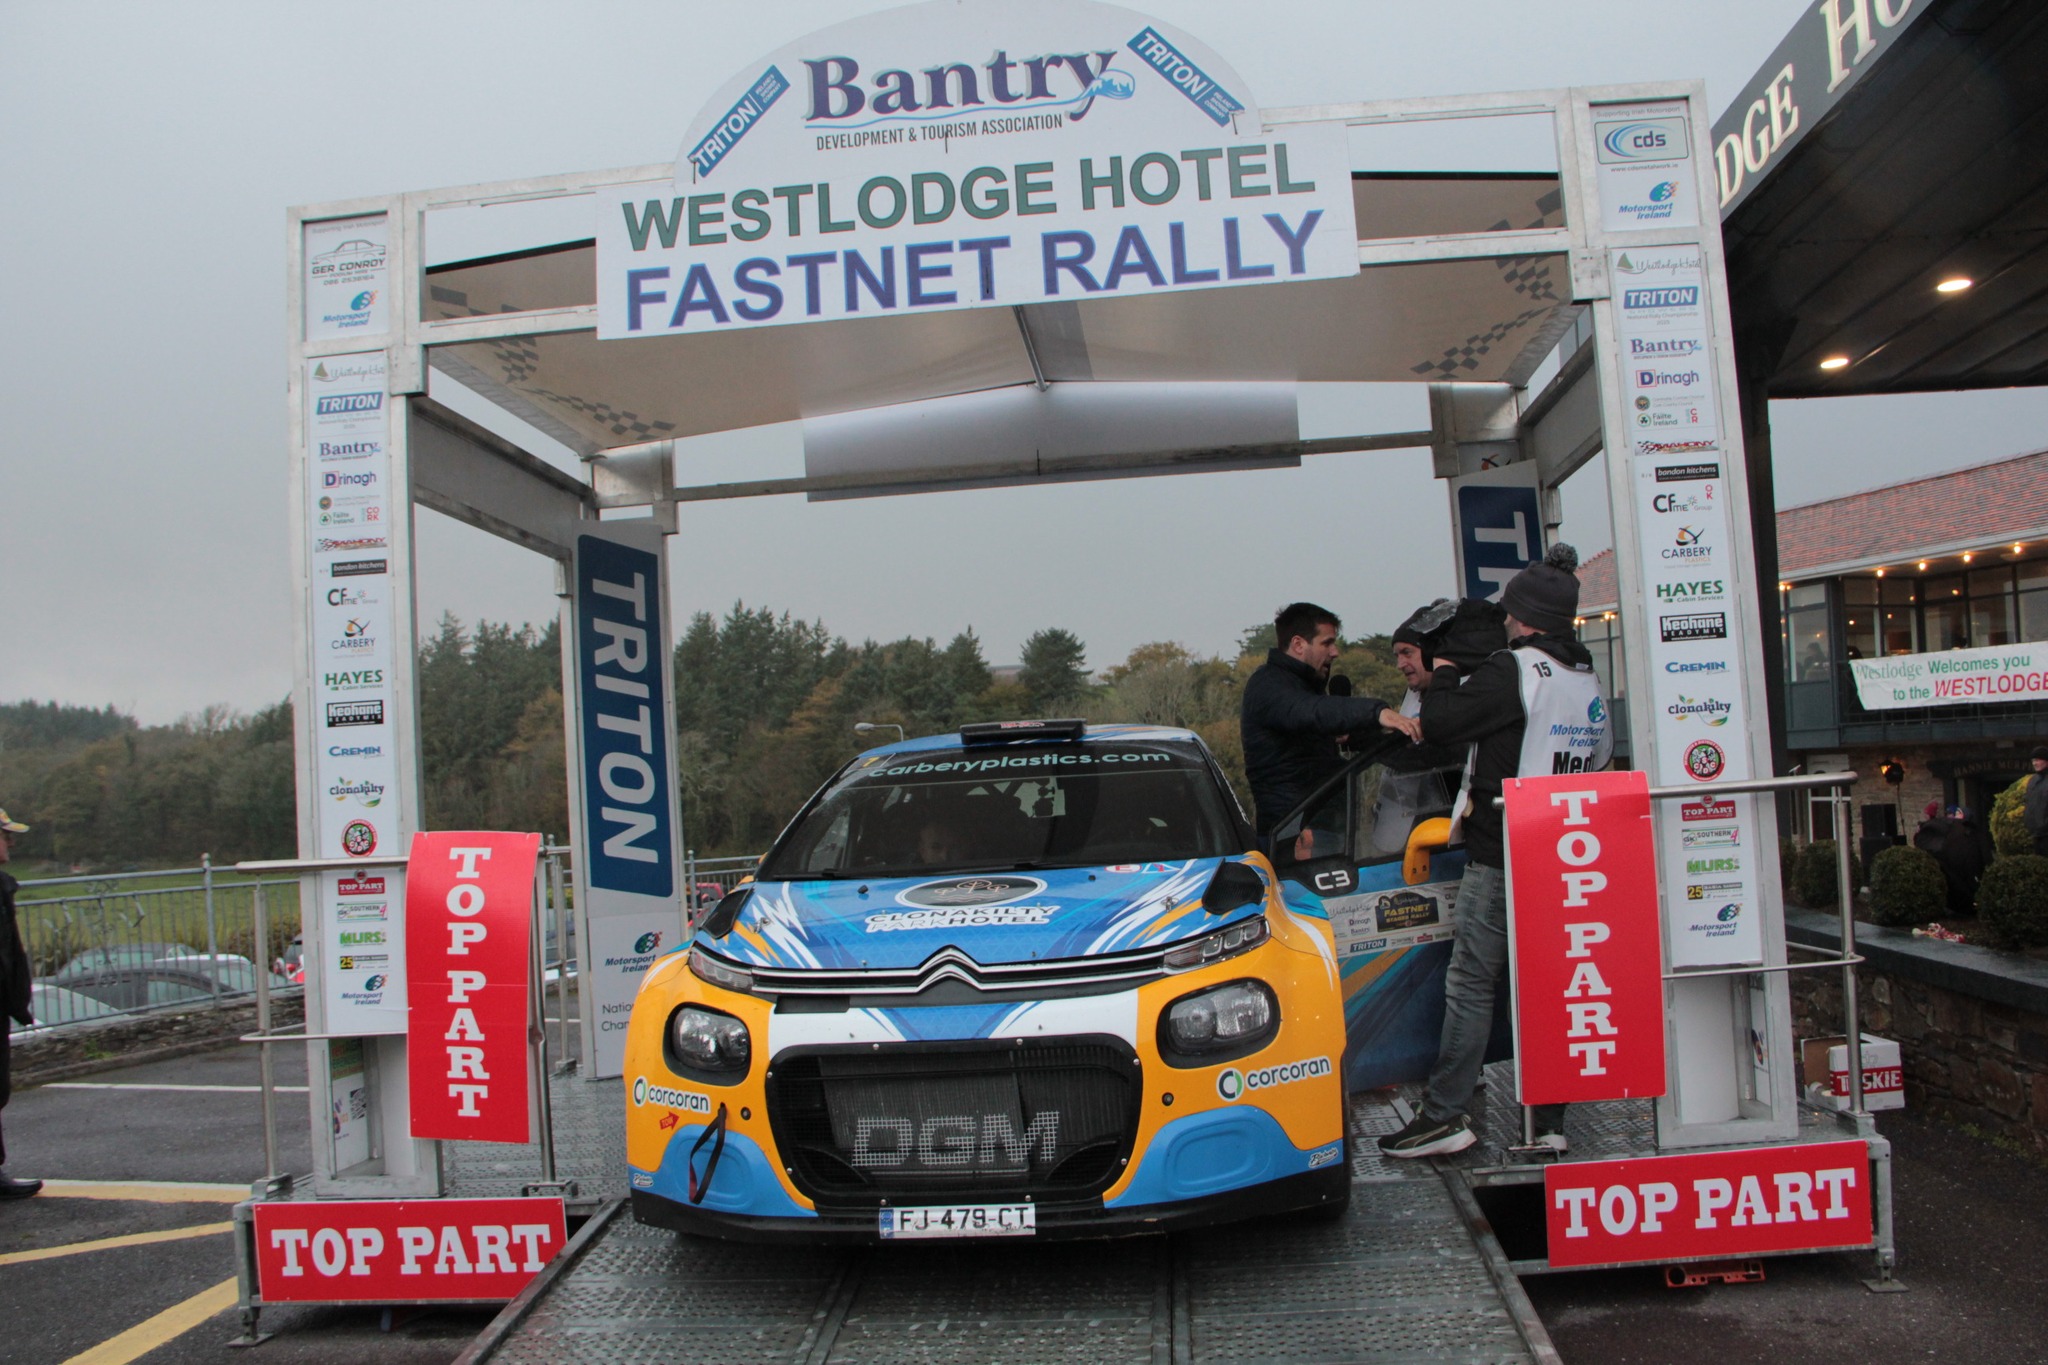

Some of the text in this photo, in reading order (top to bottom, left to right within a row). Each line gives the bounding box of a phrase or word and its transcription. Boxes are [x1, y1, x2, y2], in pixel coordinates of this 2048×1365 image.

[1137, 32, 1208, 96] TRITON
[801, 49, 1118, 121] Bantry
[689, 99, 757, 168] TRITON
[816, 113, 1063, 150] DEVELOPMENT & TOURISM ASSOCIATION
[1633, 130, 1666, 148] cds
[1713, 63, 1799, 209] DGE
[621, 143, 1316, 252] WESTLODGE HOTEL
[1619, 203, 1673, 214] Motorsport
[1636, 211, 1671, 220] Ireland
[312, 258, 386, 275] GER CONROY
[627, 209, 1324, 332] FASTNET RALLY
[1628, 289, 1693, 306] TRITON
[1631, 338, 1698, 356] Bantry
[1640, 370, 1699, 386] Drinagh
[321, 394, 380, 412] TRITON
[1653, 419, 1678, 427] Ireland
[319, 442, 379, 457] Bantry
[325, 470, 376, 486] Drinagh
[1657, 467, 1685, 476] bandon
[1686, 465, 1716, 475] kitchens
[1661, 546, 1712, 559] CARBERY
[1656, 580, 1724, 598] HAYES
[1661, 613, 1724, 631] Keohane
[331, 637, 376, 649] CARBERY
[1532, 661, 1552, 678] 15
[1665, 661, 1726, 674] CREMIN
[1928, 658, 1999, 674] Welcomes
[2003, 655, 2030, 671] you
[325, 670, 383, 686] HAYES
[1893, 672, 2048, 700] to the WESTLODGE
[592, 572, 659, 864] TRITON
[329, 746, 381, 757] CREMIN
[869, 750, 1171, 778] carberyplastics.com
[1683, 808, 1704, 816] TOP
[1706, 806, 1734, 814] PART
[1697, 830, 1731, 838] SOUTHERN
[339, 883, 358, 891] TOP
[1314, 869, 1350, 891] C3
[1688, 886, 1702, 899] 25
[869, 906, 1054, 924] CLONAKILTY
[1384, 903, 1430, 917] FASTNET
[1550, 790, 1618, 1077] TOP PART
[1689, 922, 1737, 933] Motorsport
[1706, 929, 1736, 938] Ireland
[1353, 940, 1384, 951] TRITON
[341, 957, 353, 968] 25
[605, 954, 656, 967] Motorsport
[621, 964, 652, 974] Irelan
[444, 847, 492, 1118] TOP PART
[1247, 1058, 1330, 1088] corcoran
[1837, 1070, 1902, 1093] TSKIE
[648, 1085, 709, 1112] corcoran
[852, 1111, 1059, 1167] DGM
[1555, 1167, 1856, 1239] TOP PART
[900, 1206, 1029, 1231] FJ-479-CT
[271, 1224, 551, 1277] TOP PART
